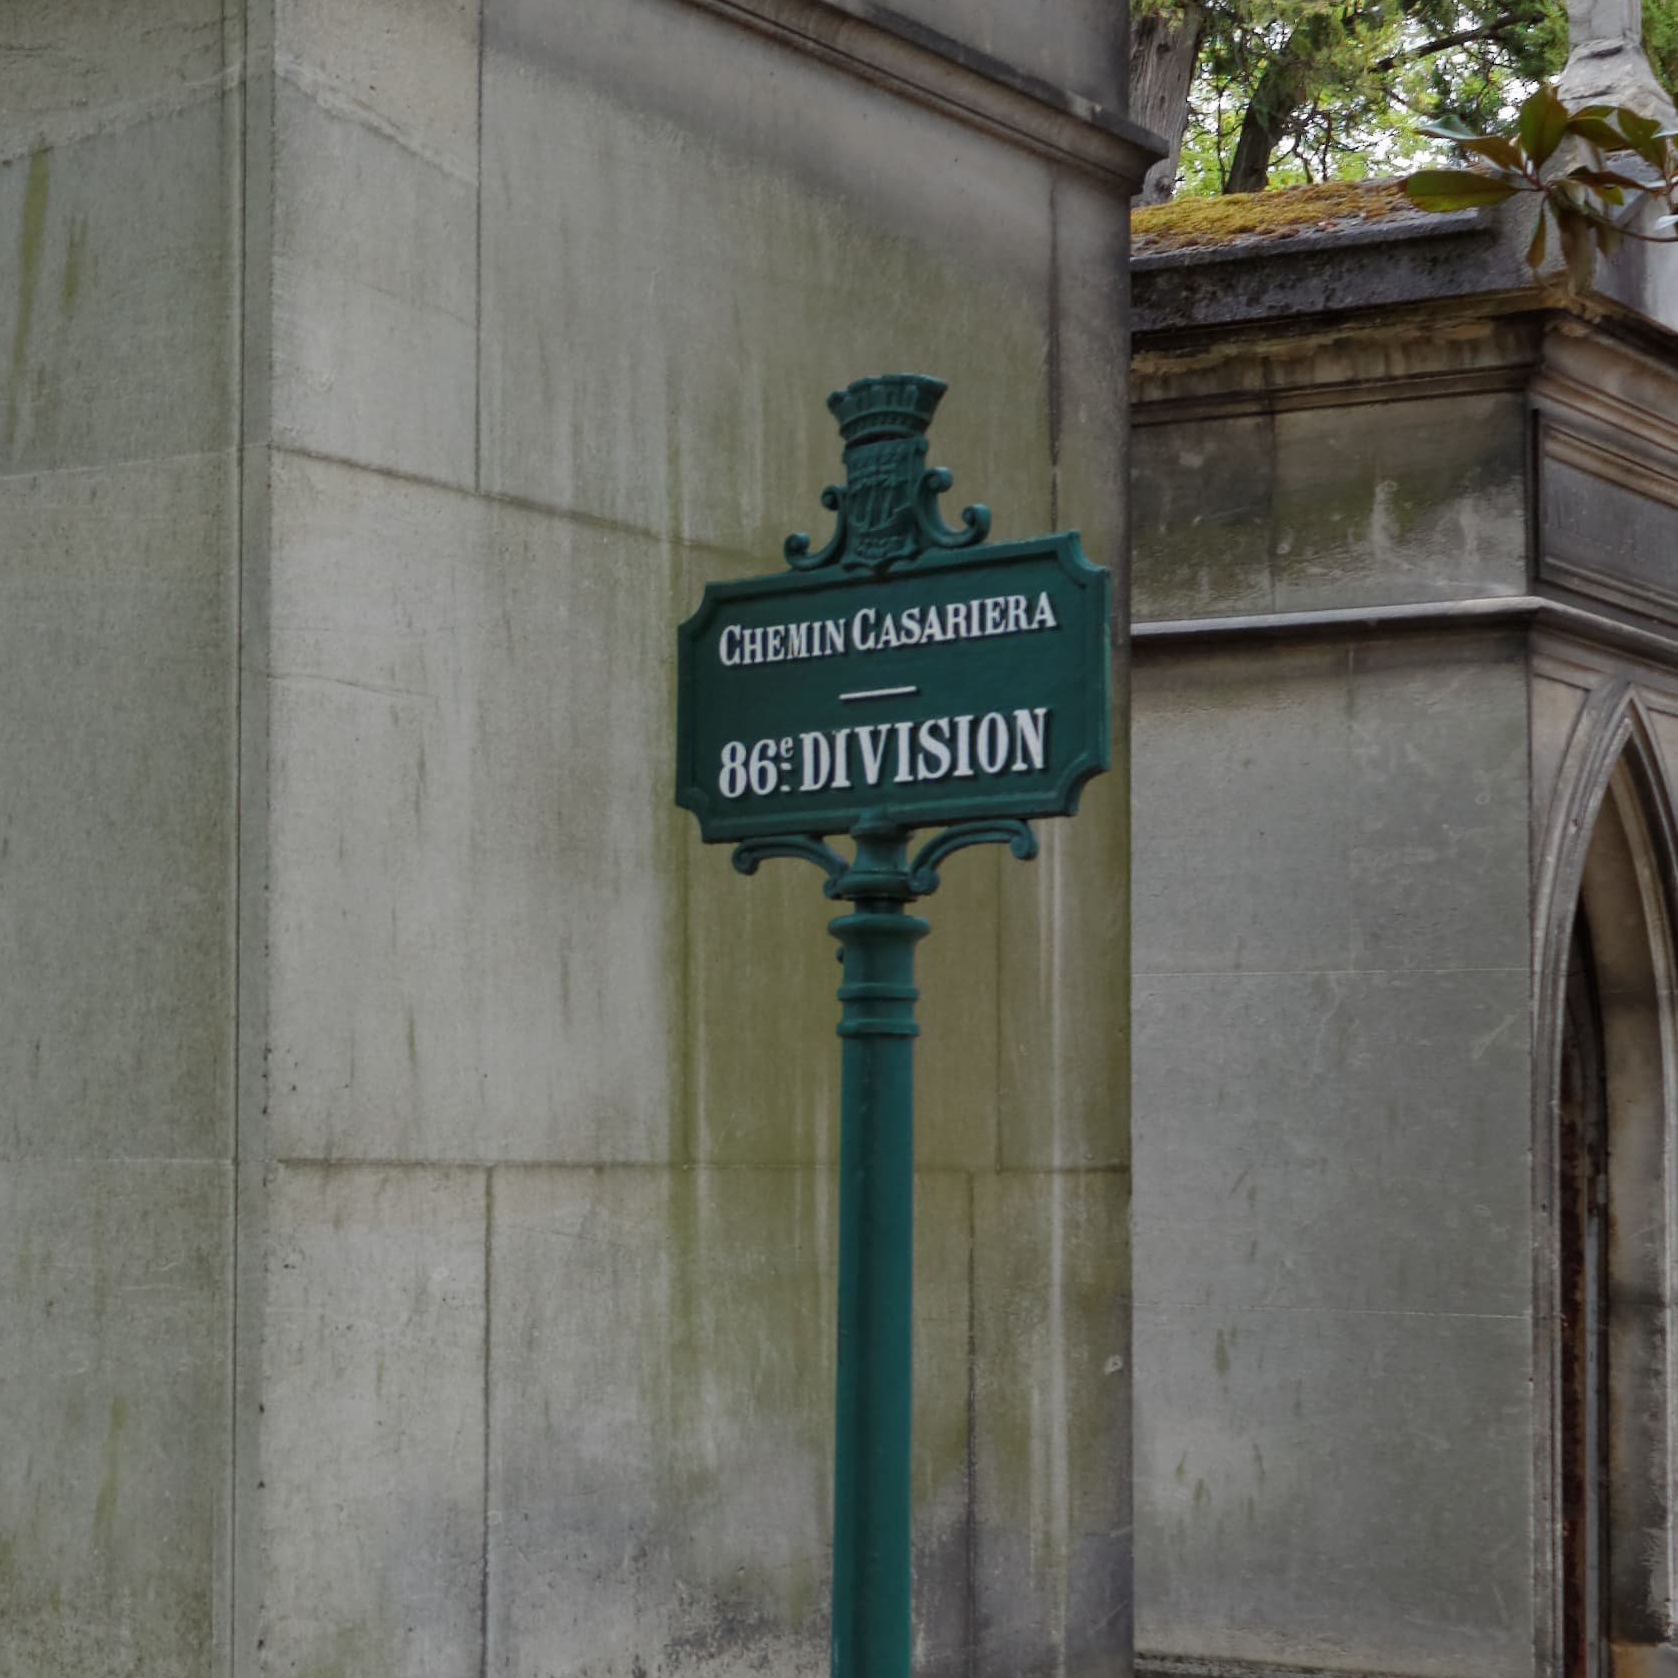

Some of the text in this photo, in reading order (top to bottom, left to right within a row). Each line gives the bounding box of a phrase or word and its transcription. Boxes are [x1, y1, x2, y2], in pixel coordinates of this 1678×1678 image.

[718, 591, 1057, 666] CHEMIN CASARIERA
[800, 708, 1048, 792] DIVISION
